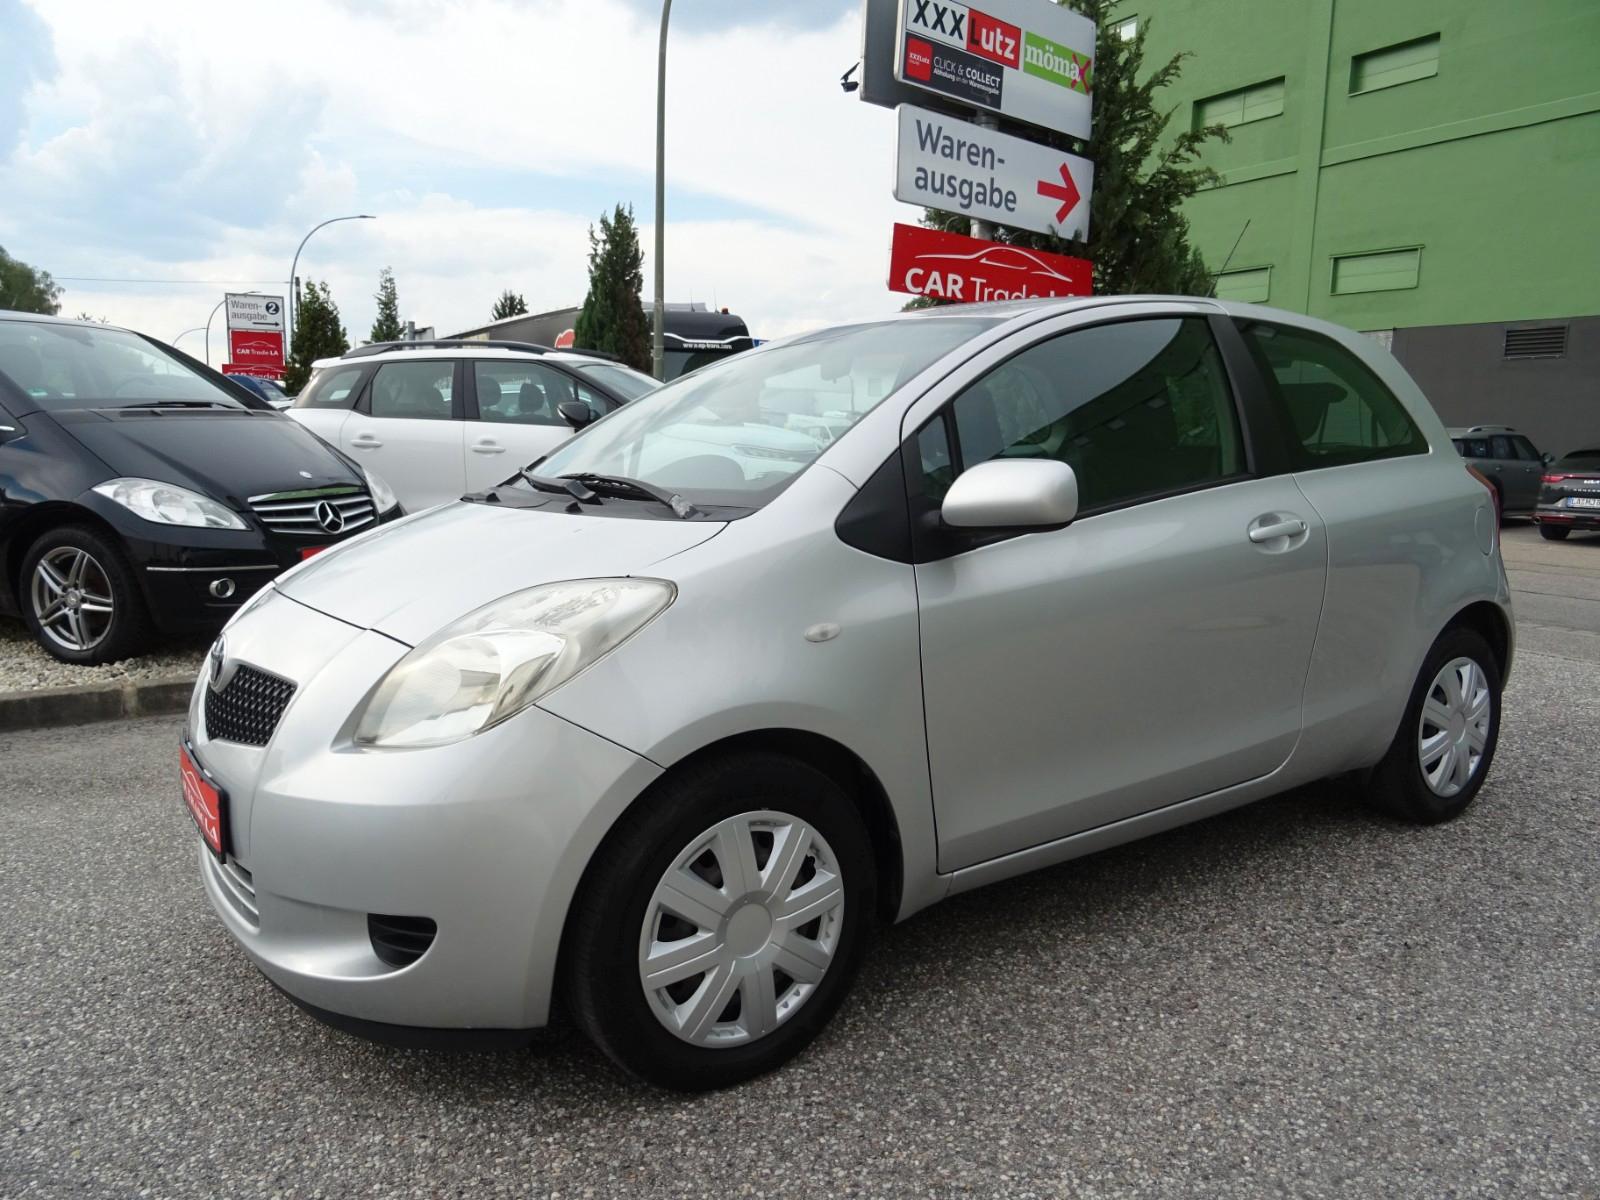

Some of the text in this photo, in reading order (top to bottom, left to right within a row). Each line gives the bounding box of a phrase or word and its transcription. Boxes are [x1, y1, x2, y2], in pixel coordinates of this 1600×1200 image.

[933, 56, 1001, 88] CLICK & COLLECT
[933, 68, 956, 82] Abholung
[968, 80, 1000, 95] Warenausgabe
[1025, 43, 1092, 95] mömax
[915, 119, 1006, 171] Waren-
[914, 167, 1017, 212] ausgabe
[904, 268, 964, 299] CAR
[230, 300, 262, 310] Waren-
[231, 312, 268, 321] ausgabe
